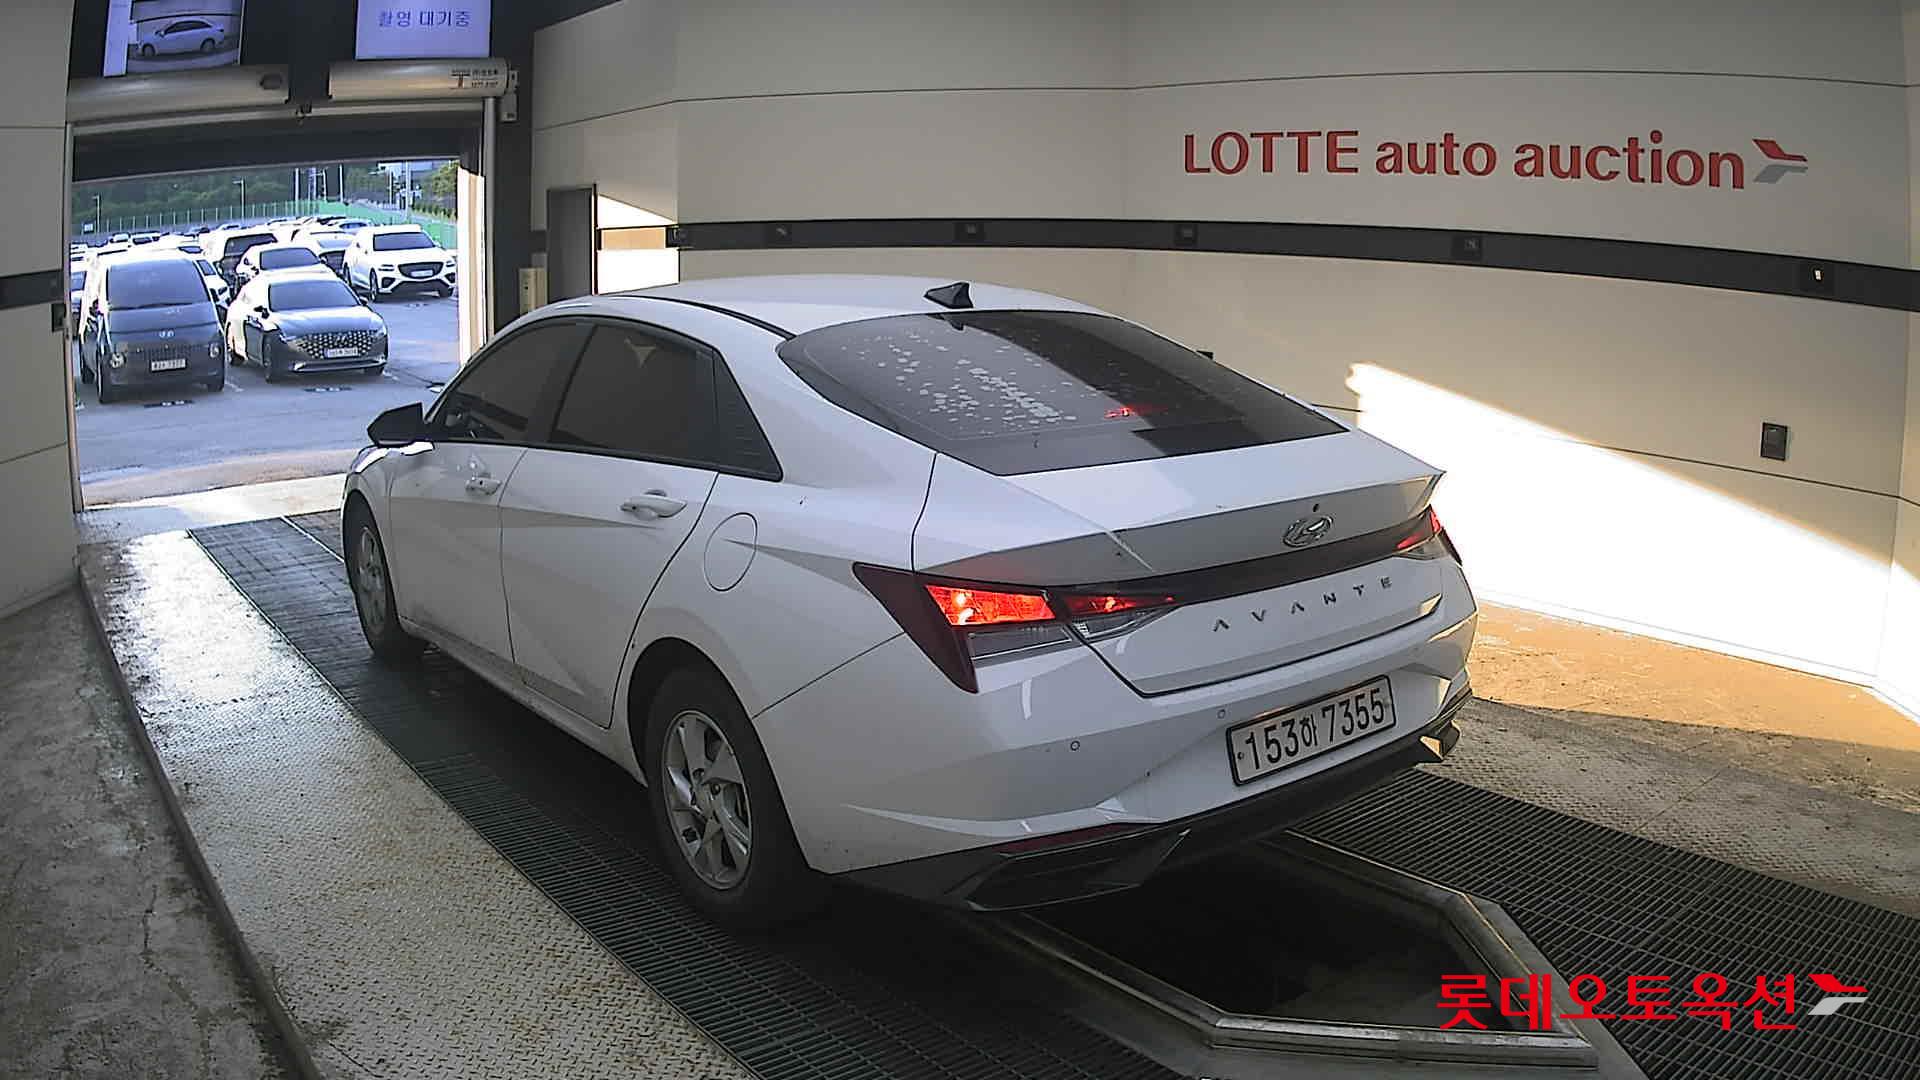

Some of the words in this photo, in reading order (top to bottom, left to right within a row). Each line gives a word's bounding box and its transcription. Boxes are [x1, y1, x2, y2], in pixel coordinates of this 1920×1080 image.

[420, 11, 470, 27] 대기중
[1184, 130, 1359, 174] LOTTE
[1375, 132, 1497, 177] auto
[1513, 129, 1745, 189] auction
[1213, 576, 1393, 633] AVANTE
[1245, 714, 1318, 770] 153하
[1321, 688, 1385, 744] 7355
